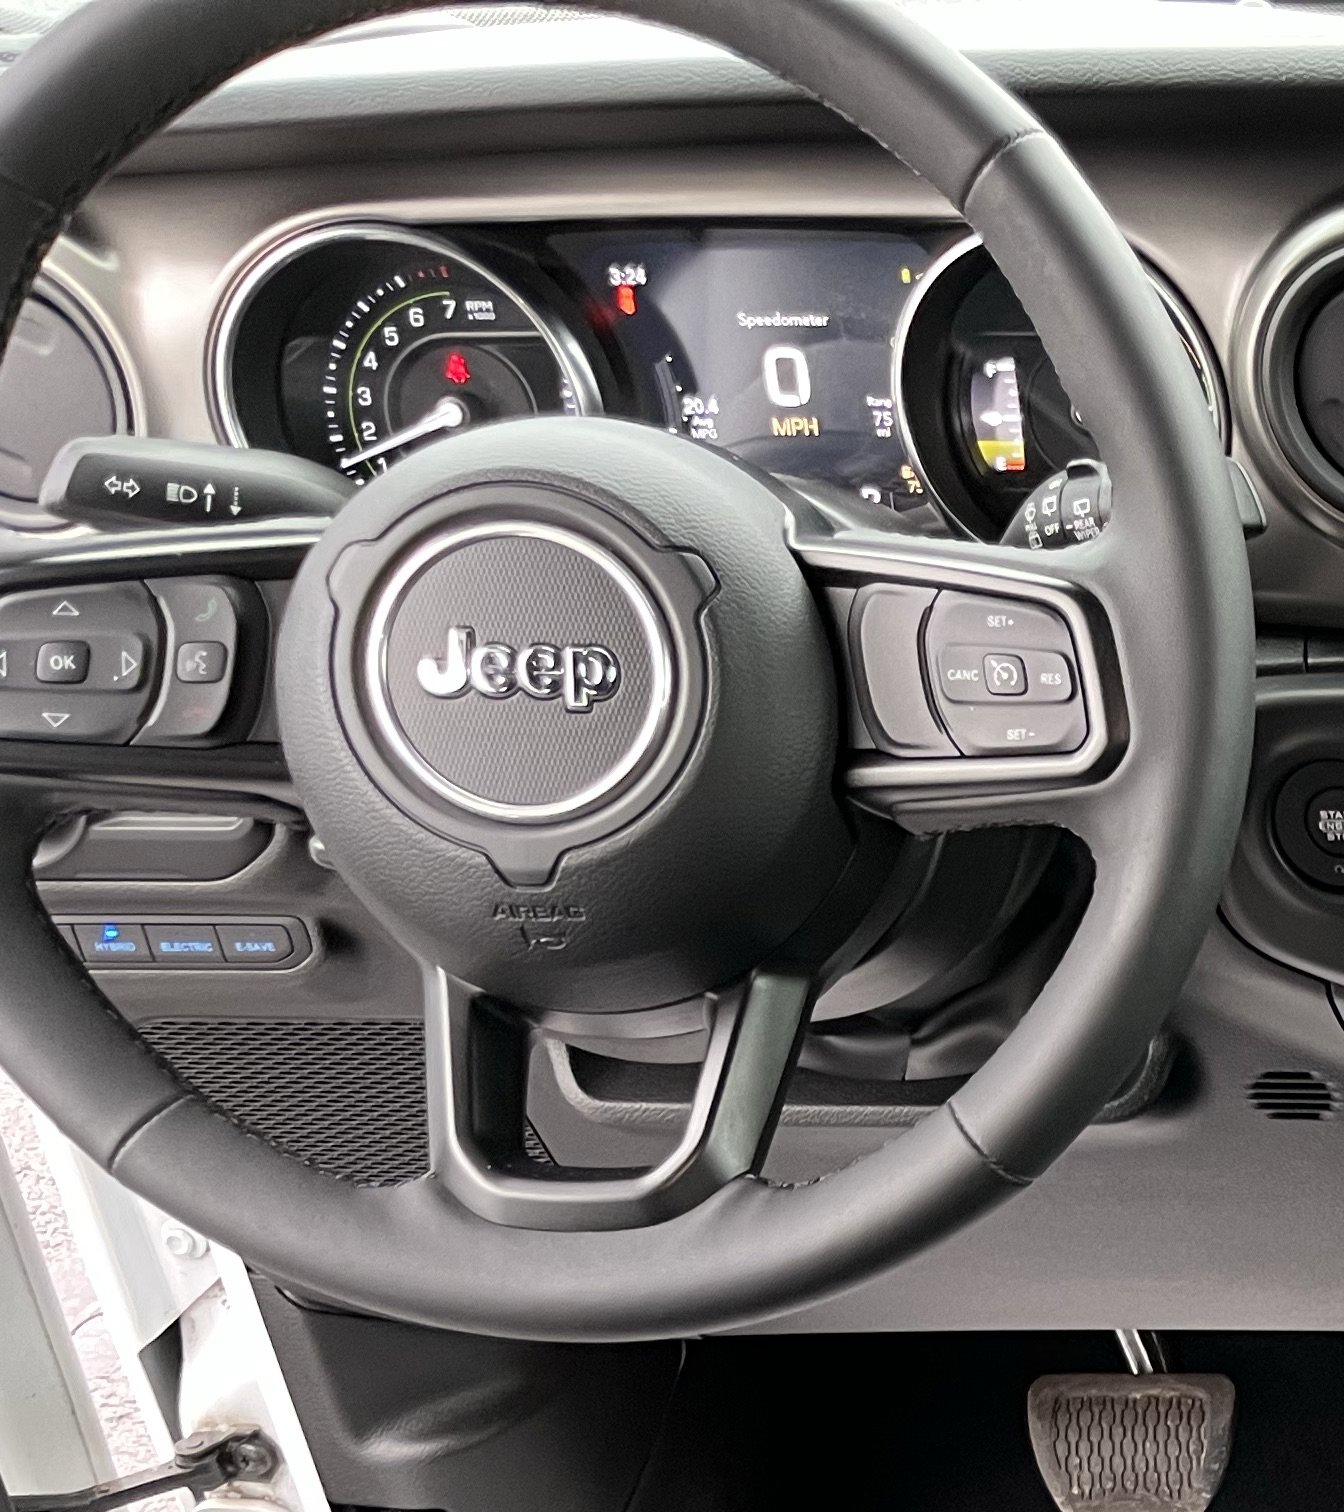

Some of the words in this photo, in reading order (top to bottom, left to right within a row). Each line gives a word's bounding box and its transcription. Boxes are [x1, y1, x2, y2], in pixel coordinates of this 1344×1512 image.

[609, 264, 648, 286] 3:24
[442, 299, 457, 319] 7
[465, 300, 493, 312] RPM
[409, 308, 424, 327] 6
[737, 312, 830, 330] Speedometer
[383, 327, 399, 346] 5
[363, 351, 378, 371] 4
[764, 347, 811, 408] 0
[357, 387, 372, 406] 3
[683, 397, 719, 416] 20.4
[692, 416, 714, 428] Avg
[772, 417, 820, 437] MPH
[872, 410, 893, 427] 75
[361, 422, 377, 441] 2
[691, 428, 718, 439] MPG
[50, 655, 75, 670] OK
[416, 625, 622, 713] Jeep
[947, 669, 979, 682] CANC
[1040, 673, 1062, 685] RES
[492, 903, 587, 922] AIRBAG
[160, 942, 213, 952] ELECTRIC
